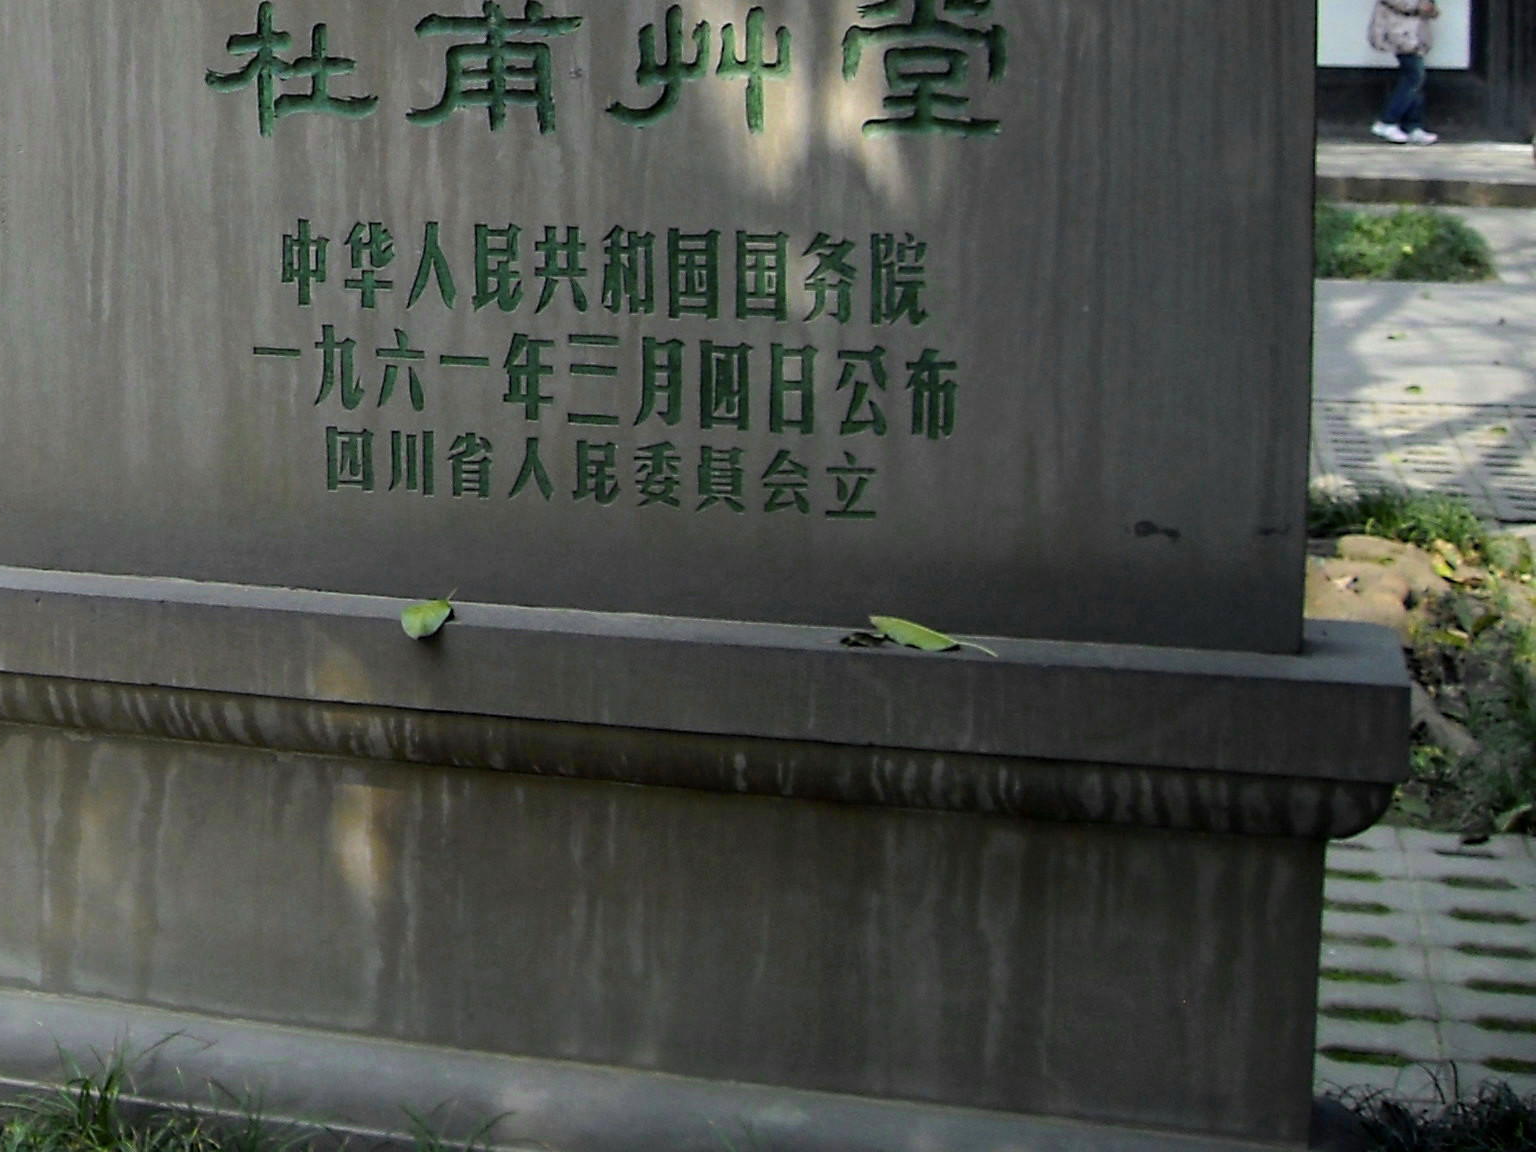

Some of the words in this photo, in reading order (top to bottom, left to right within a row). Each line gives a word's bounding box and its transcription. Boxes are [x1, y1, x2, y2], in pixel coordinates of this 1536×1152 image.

[279, 218, 930, 326] 中华人民共和国国务院
[252, 323, 960, 441] 一九六一年三月四日公布
